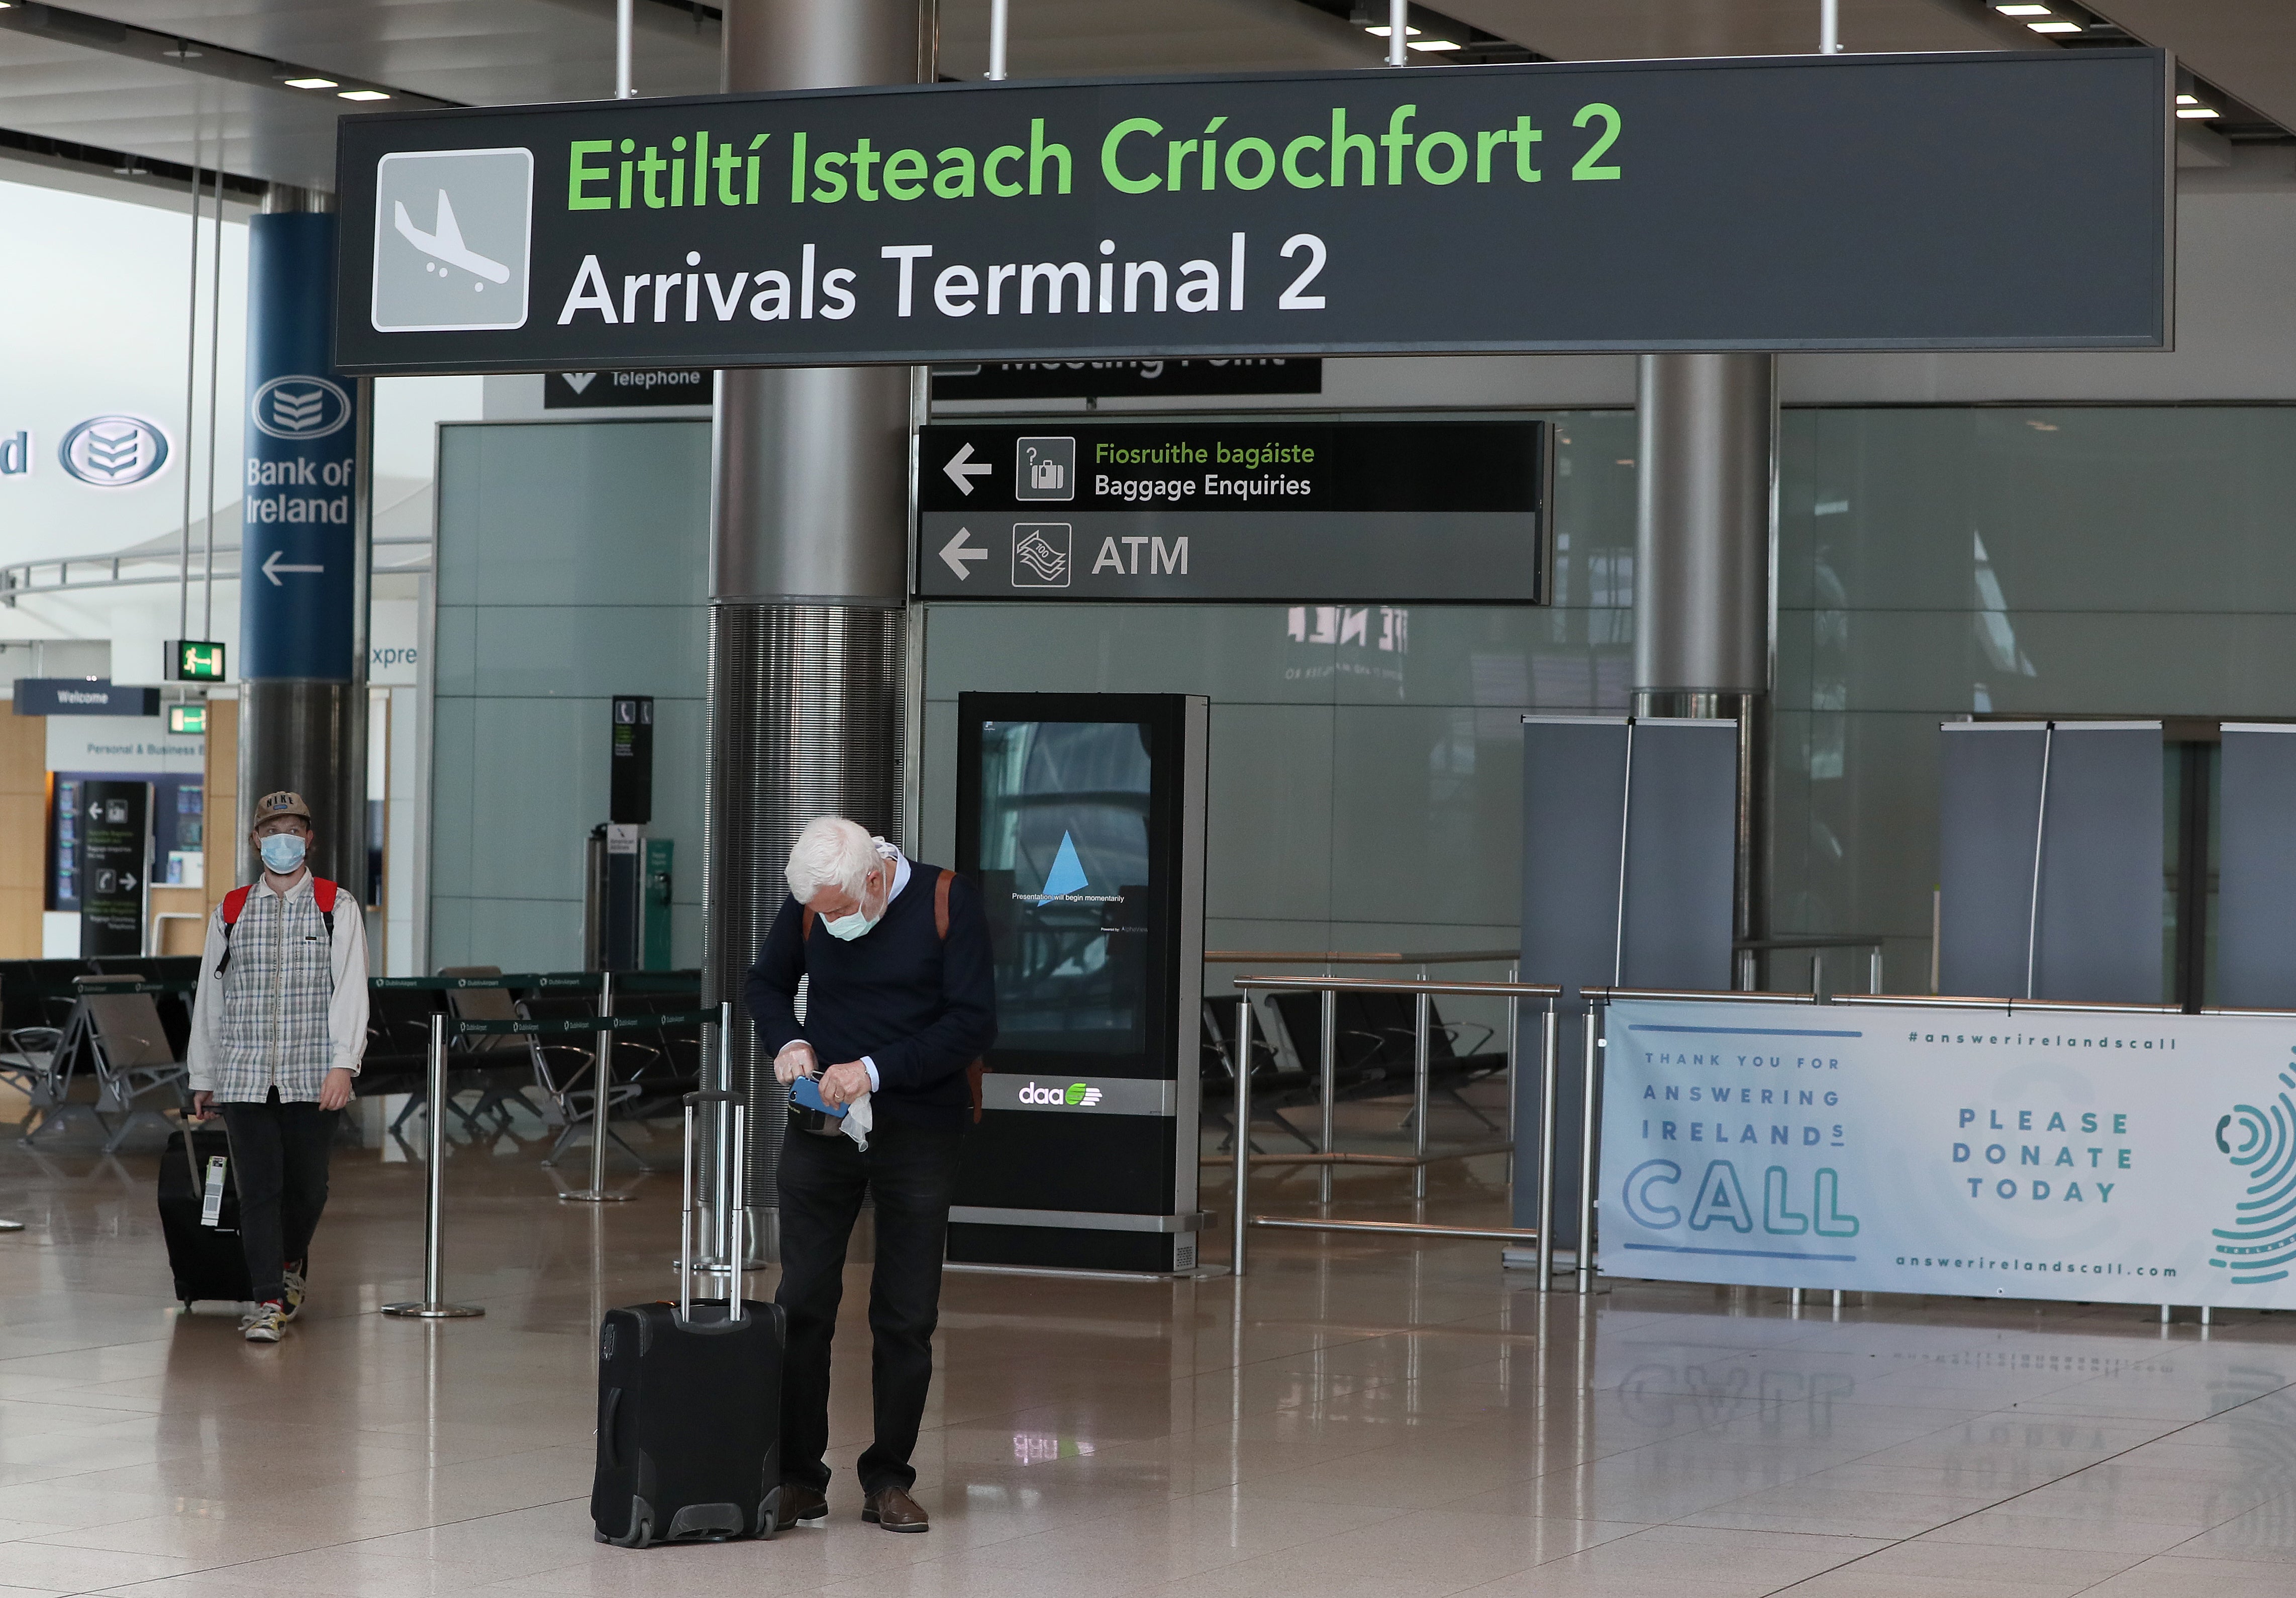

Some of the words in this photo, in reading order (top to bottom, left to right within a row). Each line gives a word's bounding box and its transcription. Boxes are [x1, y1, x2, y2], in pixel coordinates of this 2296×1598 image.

[567, 130, 771, 211] Eitiltí
[790, 118, 1072, 204] Isteach
[1101, 104, 1543, 195] Críochfort
[1571, 103, 1622, 181] 2
[556, 243, 857, 326] Arrivals
[881, 232, 1246, 318] Terminal
[1278, 233, 1327, 311] 2
[611, 371, 701, 389] Telephone
[1095, 441, 1208, 464] Fiosruithe
[1217, 441, 1315, 469] bagáiste
[247, 456, 317, 486] Bank
[322, 458, 354, 487] of
[1095, 474, 1196, 502] Baggage
[1205, 473, 1311, 501] Enquiries
[246, 493, 348, 524] Ireland
[1091, 536, 1188, 574] ATM
[371, 648, 418, 669] xpre
[57, 689, 109, 704] Welcome
[87, 743, 134, 754] Personal
[137, 743, 144, 754] &
[146, 743, 195, 754] Business
[266, 794, 293, 808] NIKE
[1084, 895, 1125, 903] momentarily
[1908, 1031, 2176, 1050] #answerirelandscall
[1645, 1052, 1721, 1066] THANK
[1737, 1055, 1780, 1068] YOU
[1796, 1057, 1839, 1070] FOR
[1019, 1082, 1064, 1105] daa
[1643, 1084, 1839, 1107] ANSWERING
[1958, 1108, 2127, 1135] PLEASE
[1952, 1142, 2132, 1169] DONATE
[1622, 1158, 1860, 1238] CALL
[1967, 1177, 2115, 1204] TODAY
[1895, 1257, 2177, 1277] answerirelandscall.com
